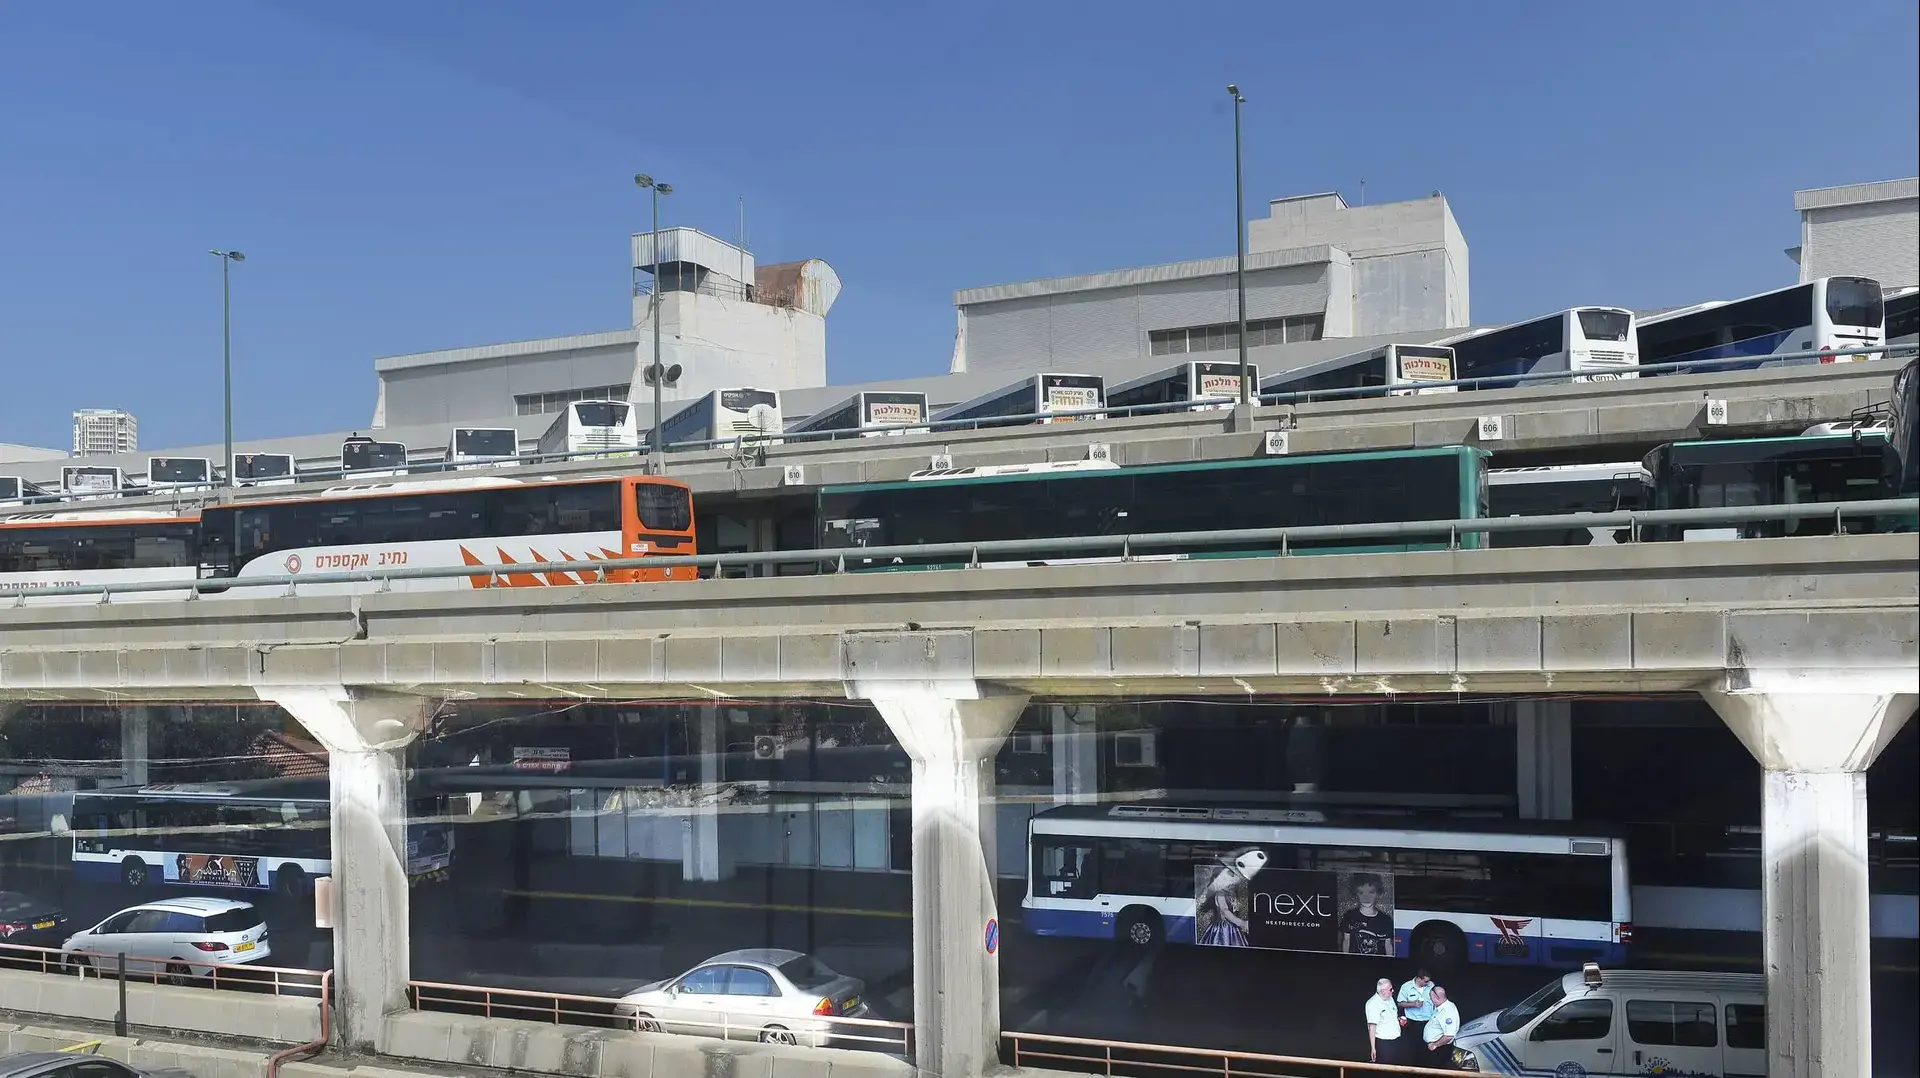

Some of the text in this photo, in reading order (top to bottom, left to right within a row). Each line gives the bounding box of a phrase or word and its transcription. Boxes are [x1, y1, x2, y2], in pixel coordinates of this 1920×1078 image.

[1403, 359, 1447, 371] דבר מלכות
[1204, 377, 1231, 388] מלכות
[873, 405, 917, 416] דבר מלכות
[1711, 407, 1724, 416] 605
[1483, 424, 1498, 433] 606
[1270, 439, 1283, 447] 607
[1093, 451, 1106, 459] 608
[935, 461, 949, 469] 609
[788, 471, 800, 479] 610
[315, 551, 408, 570] נתיב אקספרס
[1253, 892, 1332, 917] next
[1265, 920, 1321, 928] NEXTDIRECT.COM
